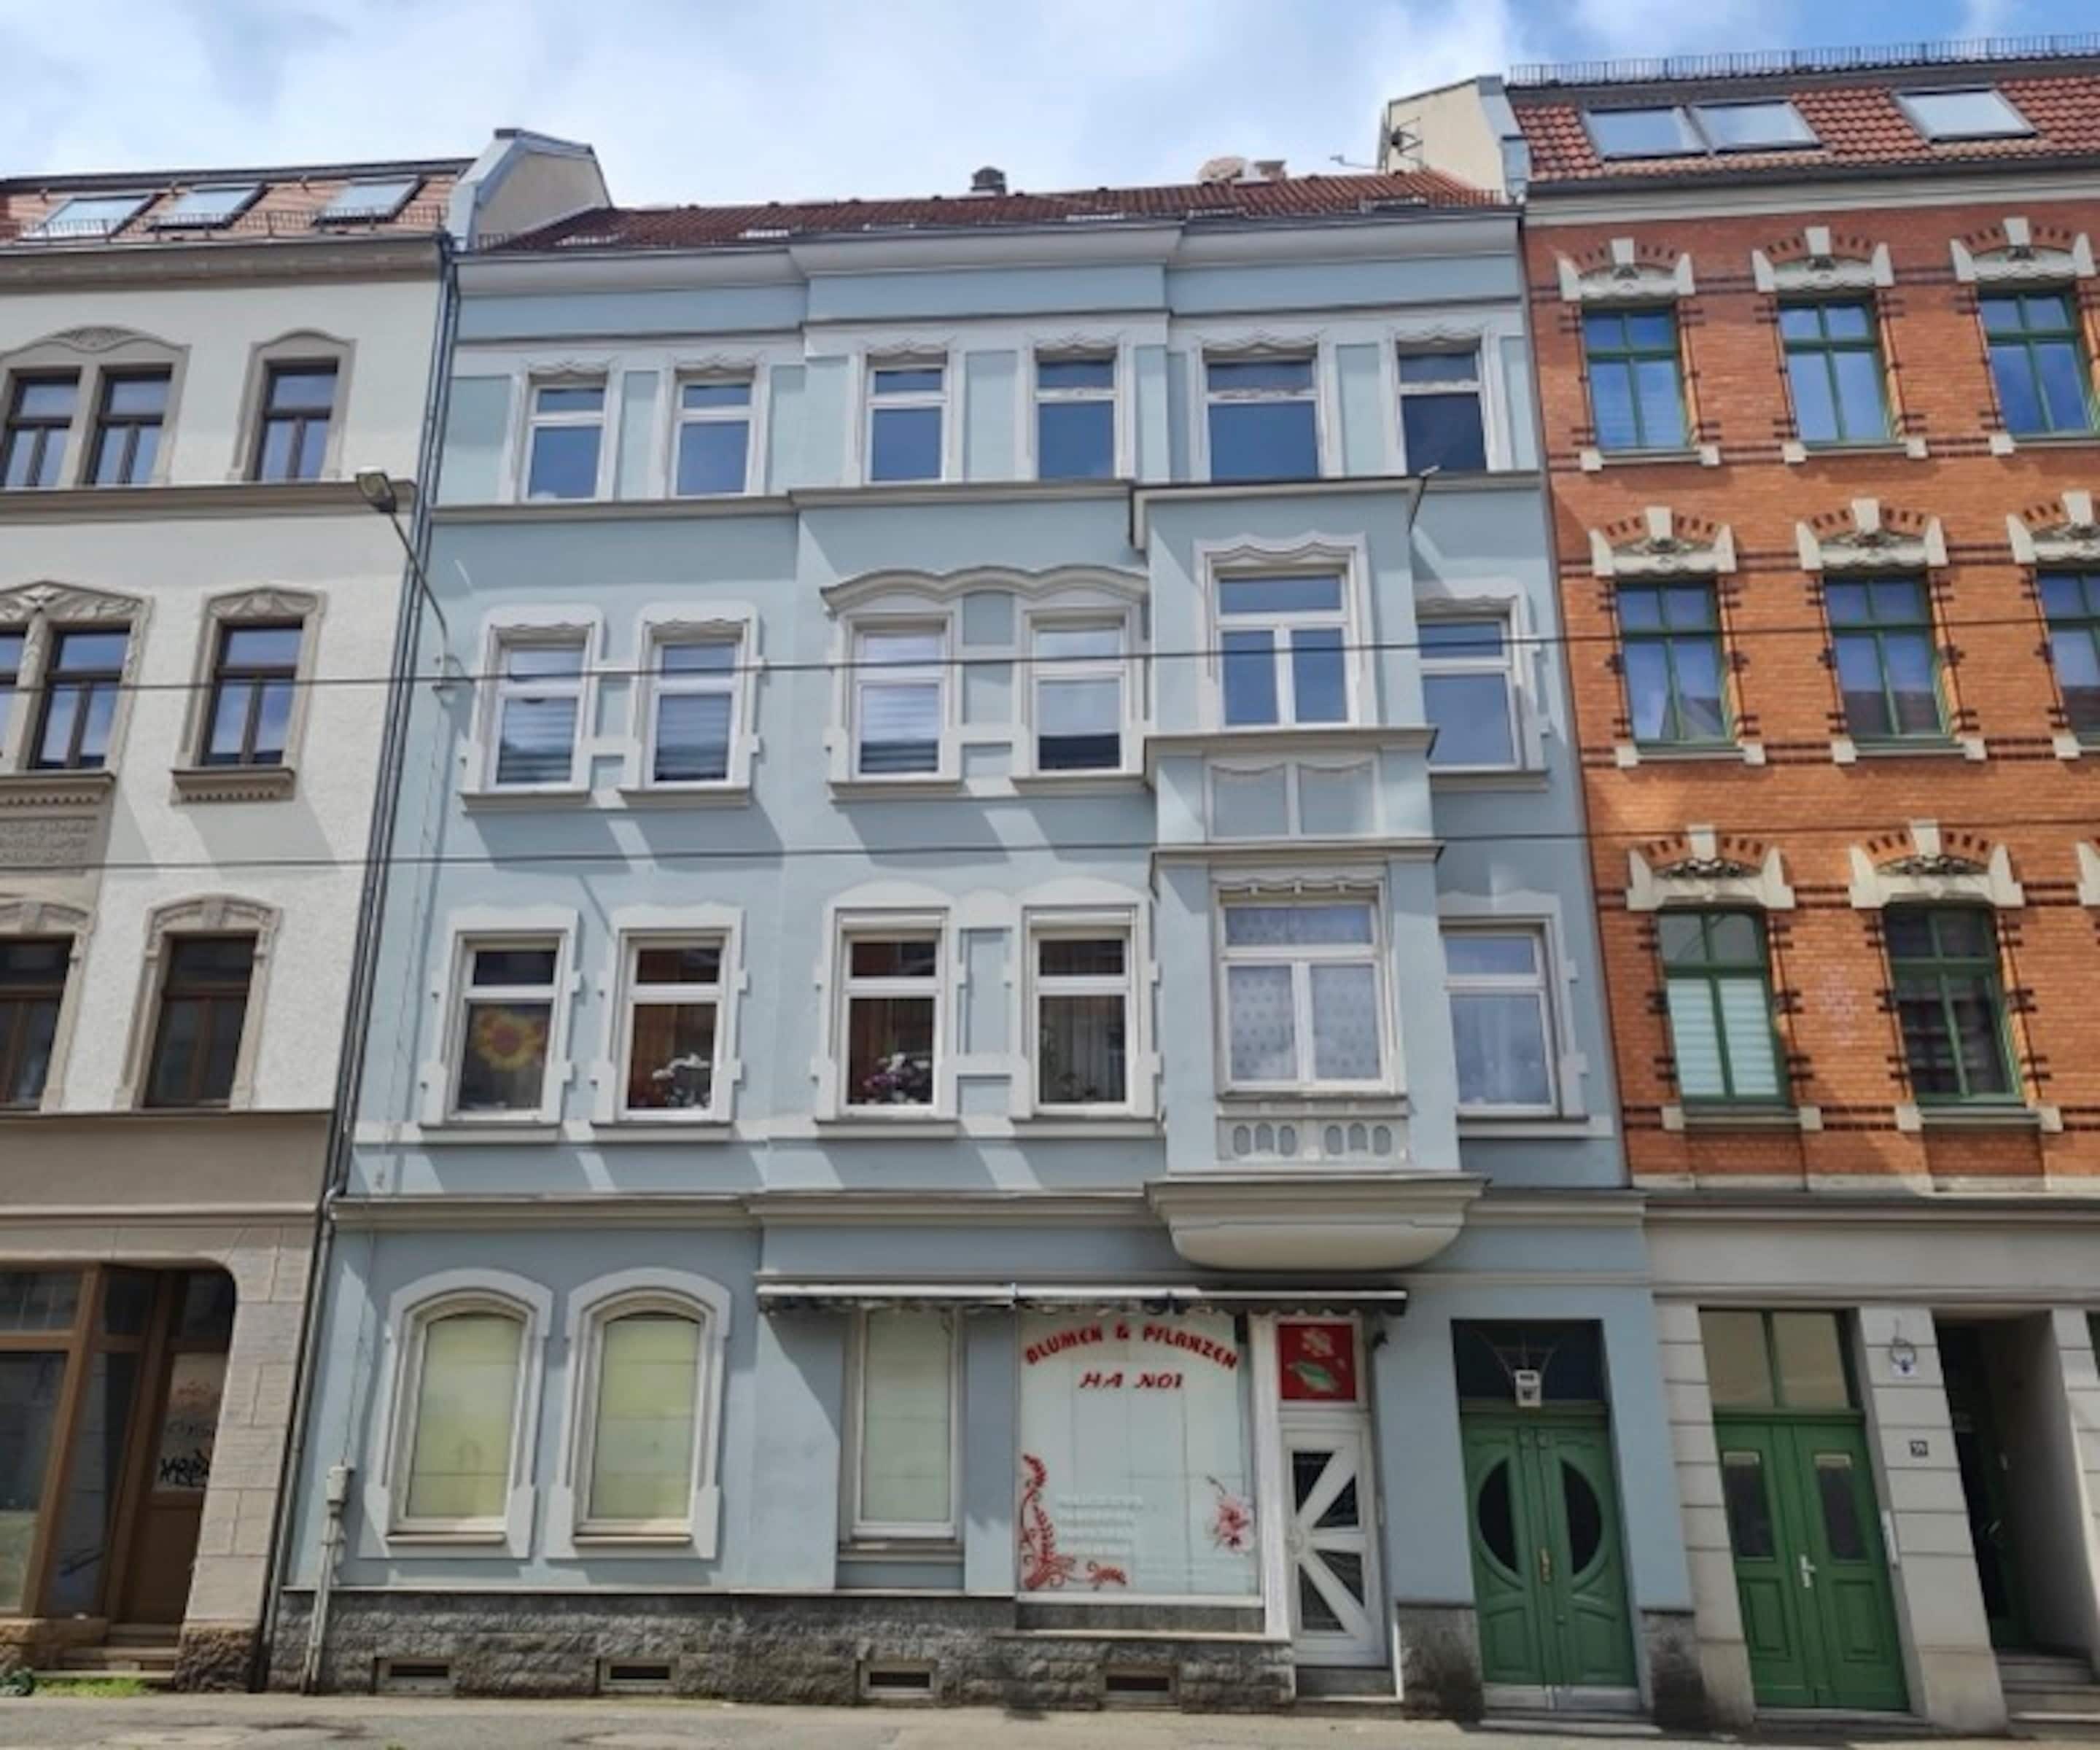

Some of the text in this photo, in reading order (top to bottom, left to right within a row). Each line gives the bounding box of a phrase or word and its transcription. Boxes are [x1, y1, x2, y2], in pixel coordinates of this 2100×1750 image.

[1026, 1321, 1237, 1369] BLUMEN & PFLANZEN
[1079, 1372, 1183, 1388] HA NOI
